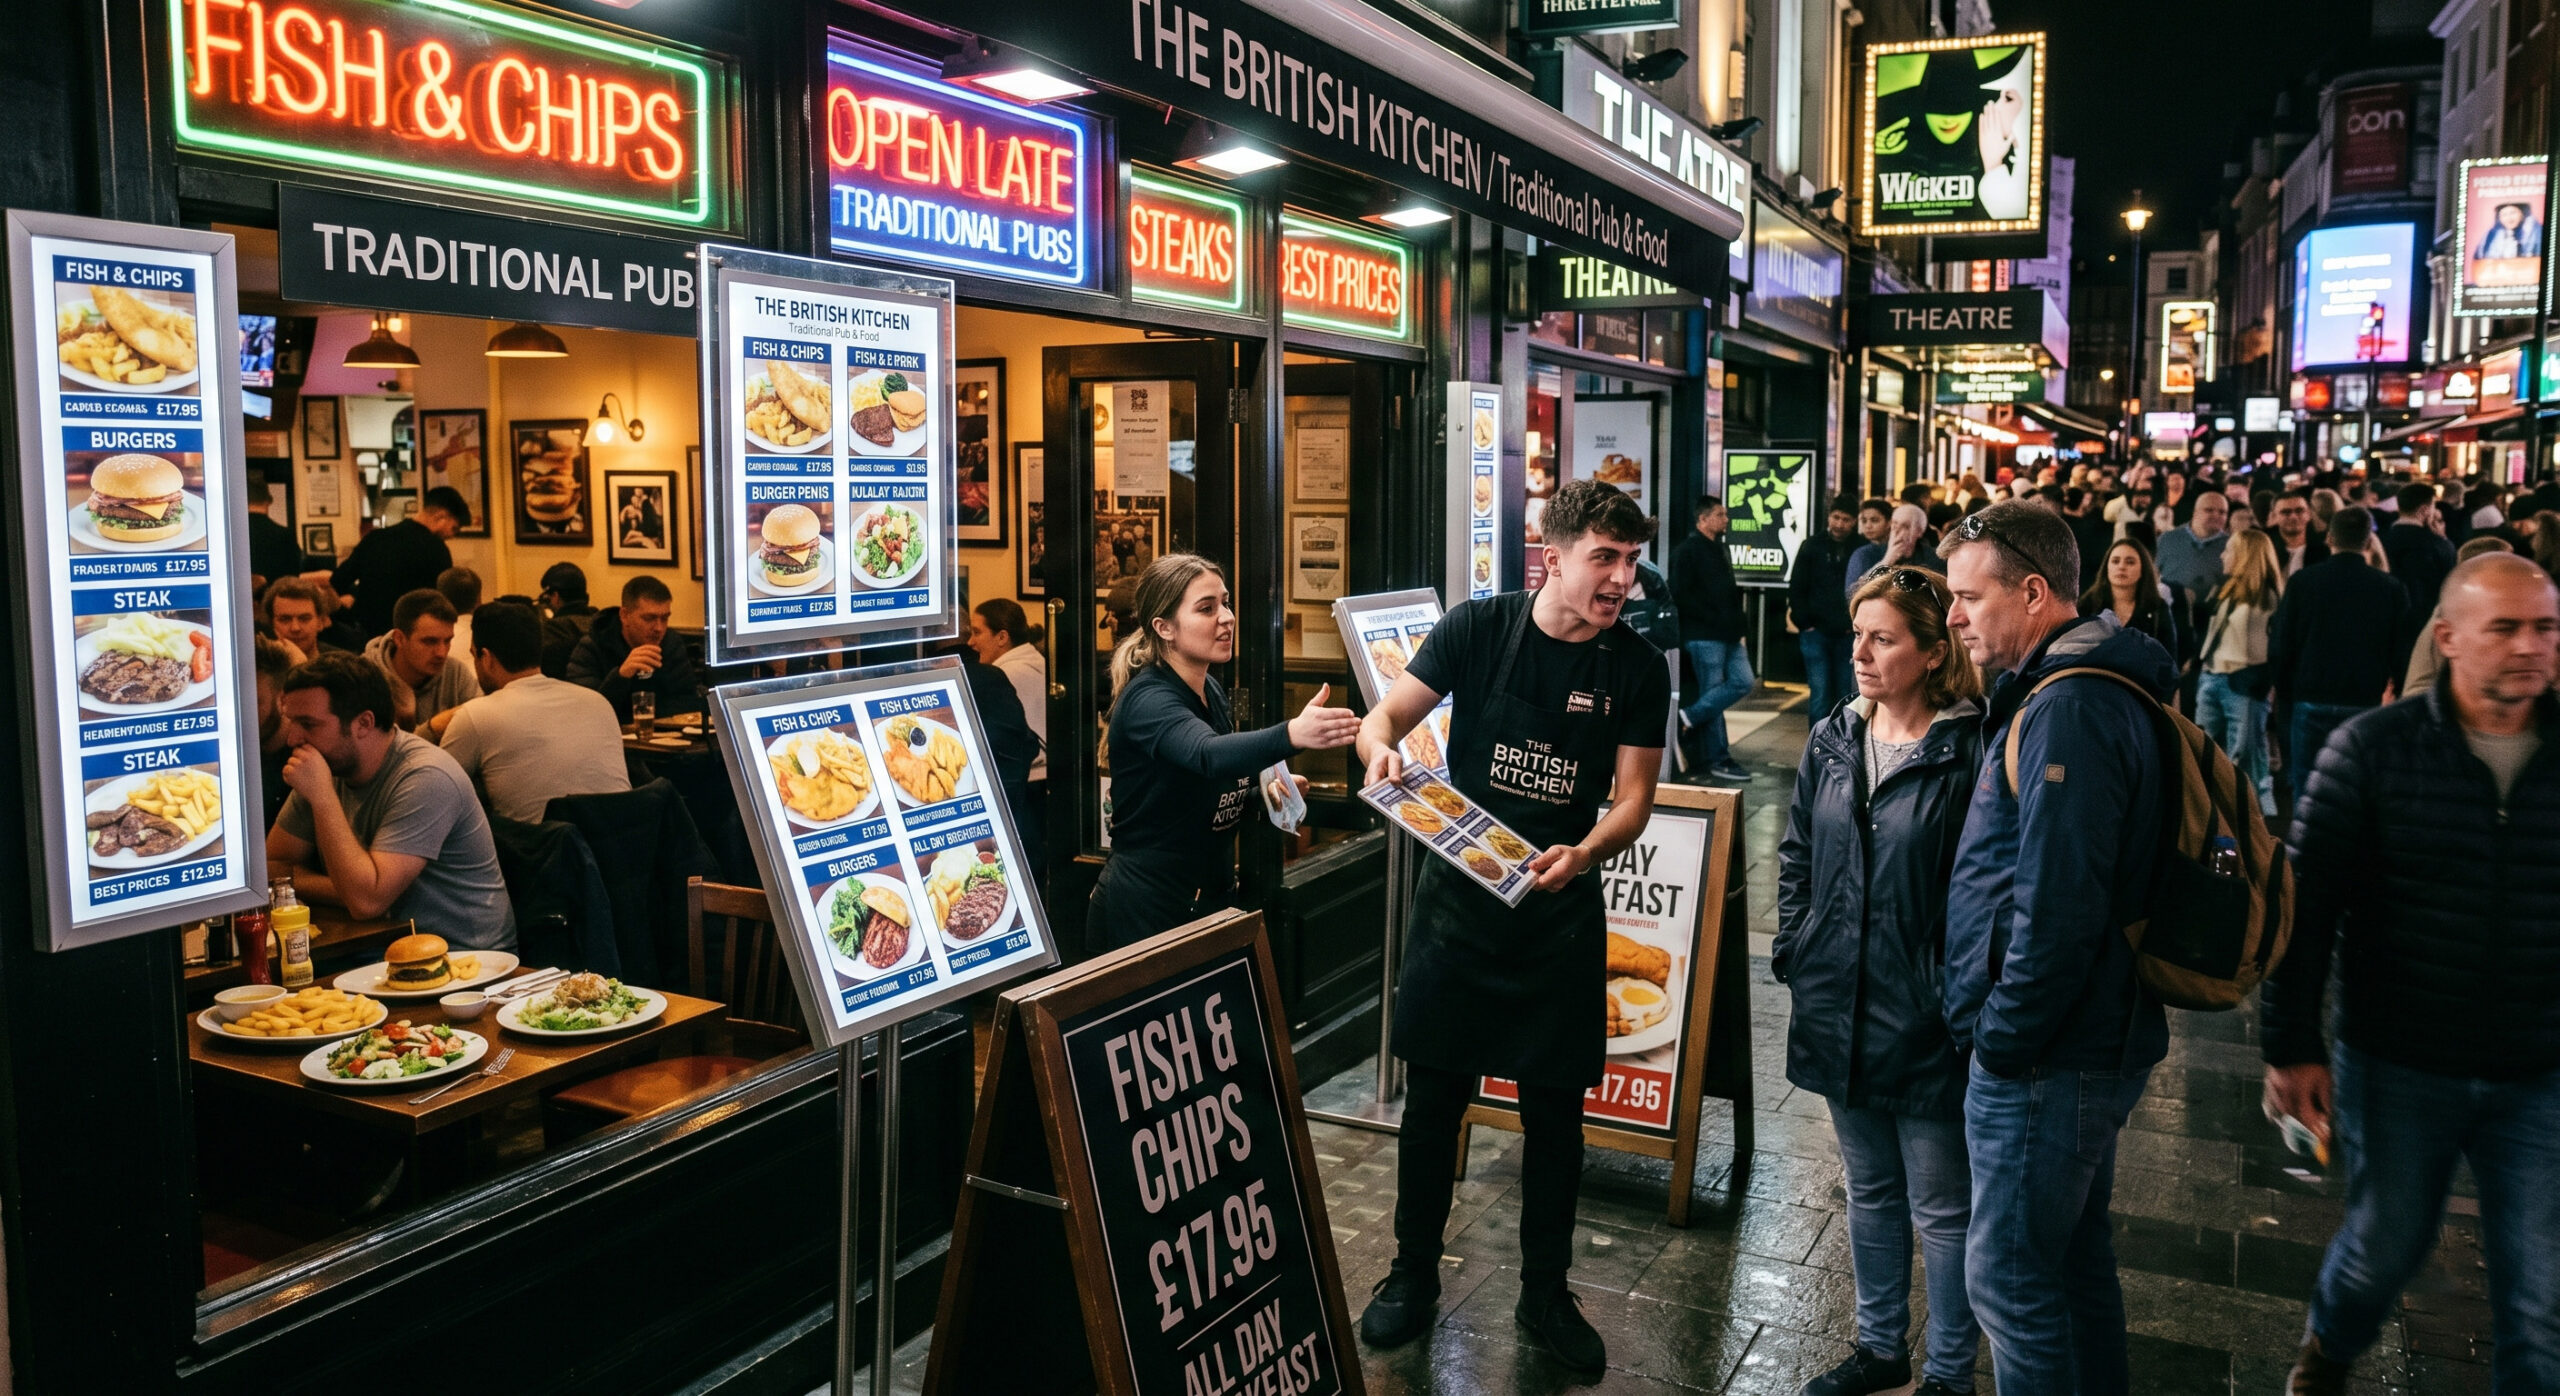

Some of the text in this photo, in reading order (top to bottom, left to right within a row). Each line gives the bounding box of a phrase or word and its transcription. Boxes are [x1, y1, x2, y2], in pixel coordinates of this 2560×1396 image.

[189, 0, 685, 182] FISH & CHIPS
[1131, 0, 1211, 90] THE
[1222, 28, 1360, 146] BRITISH
[1368, 93, 1482, 196] KITCHEN
[1498, 153, 1589, 237] Traditional
[1592, 198, 1620, 249] Pub
[1622, 212, 1634, 255] &
[1636, 217, 1668, 268] Food
[828, 87, 1075, 214] OPEN LATE
[832, 184, 1073, 265] TRADITIONAL PUBS
[1131, 204, 1233, 283] STEAKS
[65, 261, 184, 288] FISH & CHIPS
[313, 221, 696, 309] TRADITIONAL PUB
[1282, 241, 1401, 316] BEST PRICES
[755, 296, 910, 331] THE BRITISH KITCHEN
[1889, 307, 2014, 331] THEATRE
[788, 322, 880, 342] Traditional Pub & Food
[752, 341, 825, 361] FISH & CHIPS
[156, 402, 200, 417] £17.95
[91, 431, 177, 449] BURGERS
[752, 486, 829, 500] BURGER PENIS
[165, 560, 207, 573] £17.95
[113, 589, 172, 609] STEAK
[771, 716, 799, 733] FISH
[808, 709, 842, 727] CHIPS
[879, 700, 901, 715] FISH
[122, 748, 182, 771] STEAK
[1493, 743, 1578, 777] BRITISH
[1525, 738, 1552, 754] THE
[1489, 761, 1575, 795] KITCHEN
[913, 839, 931, 854] ALL
[828, 853, 878, 878] BURGERS
[94, 864, 224, 900] BEST PRICES £12.95
[1105, 992, 1238, 1123] FISH &
[1131, 1082, 1252, 1215] CHIPS
[1148, 1178, 1278, 1334] £17.95
[1184, 1297, 1284, 1396] ALL DAY
